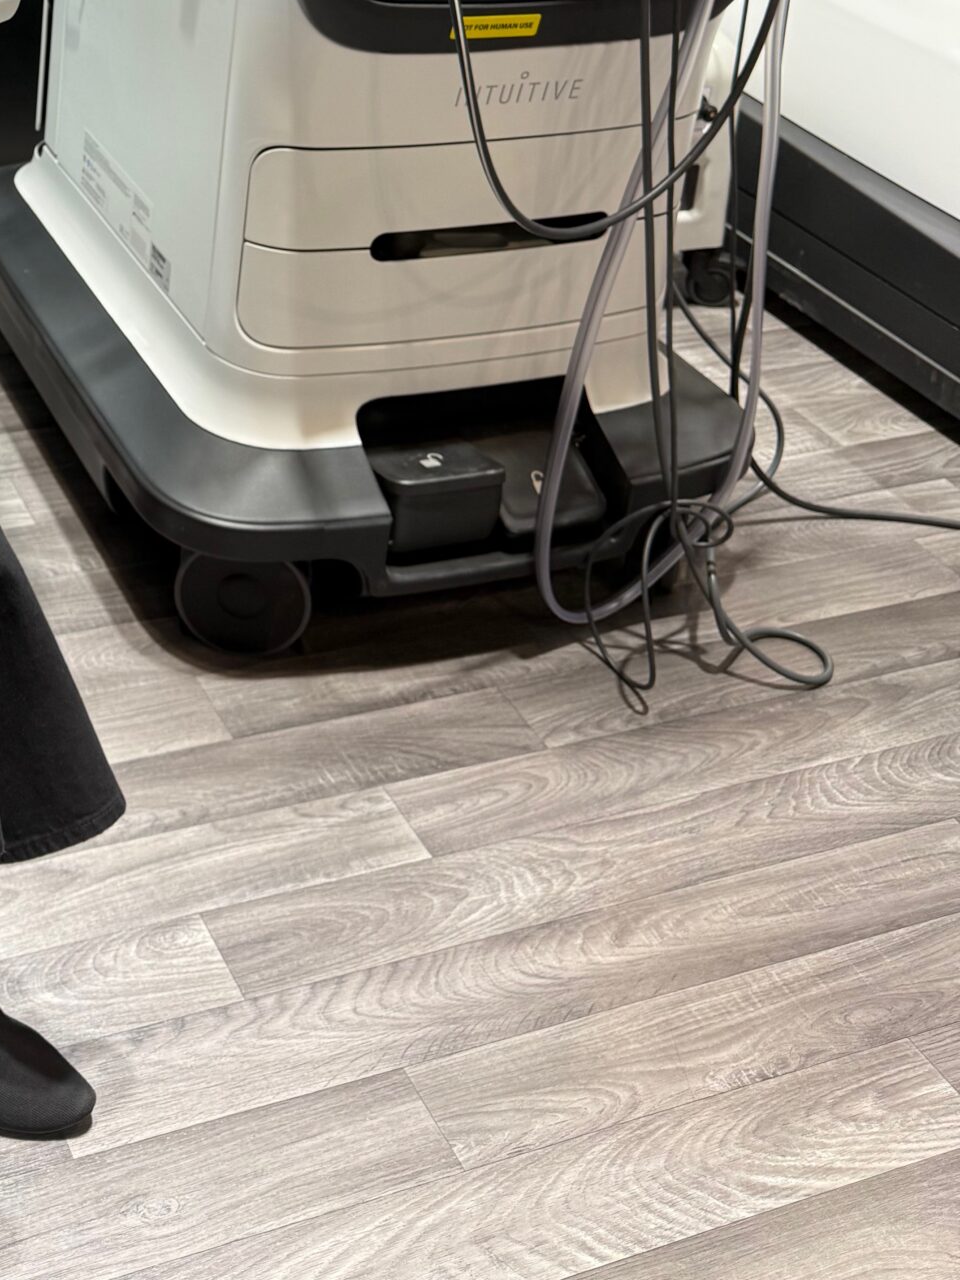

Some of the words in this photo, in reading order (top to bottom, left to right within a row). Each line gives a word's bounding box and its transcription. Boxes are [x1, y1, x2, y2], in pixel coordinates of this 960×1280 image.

[474, 23, 489, 31] FOR
[489, 22, 518, 30] HUMAN
[519, 21, 534, 29] USE
